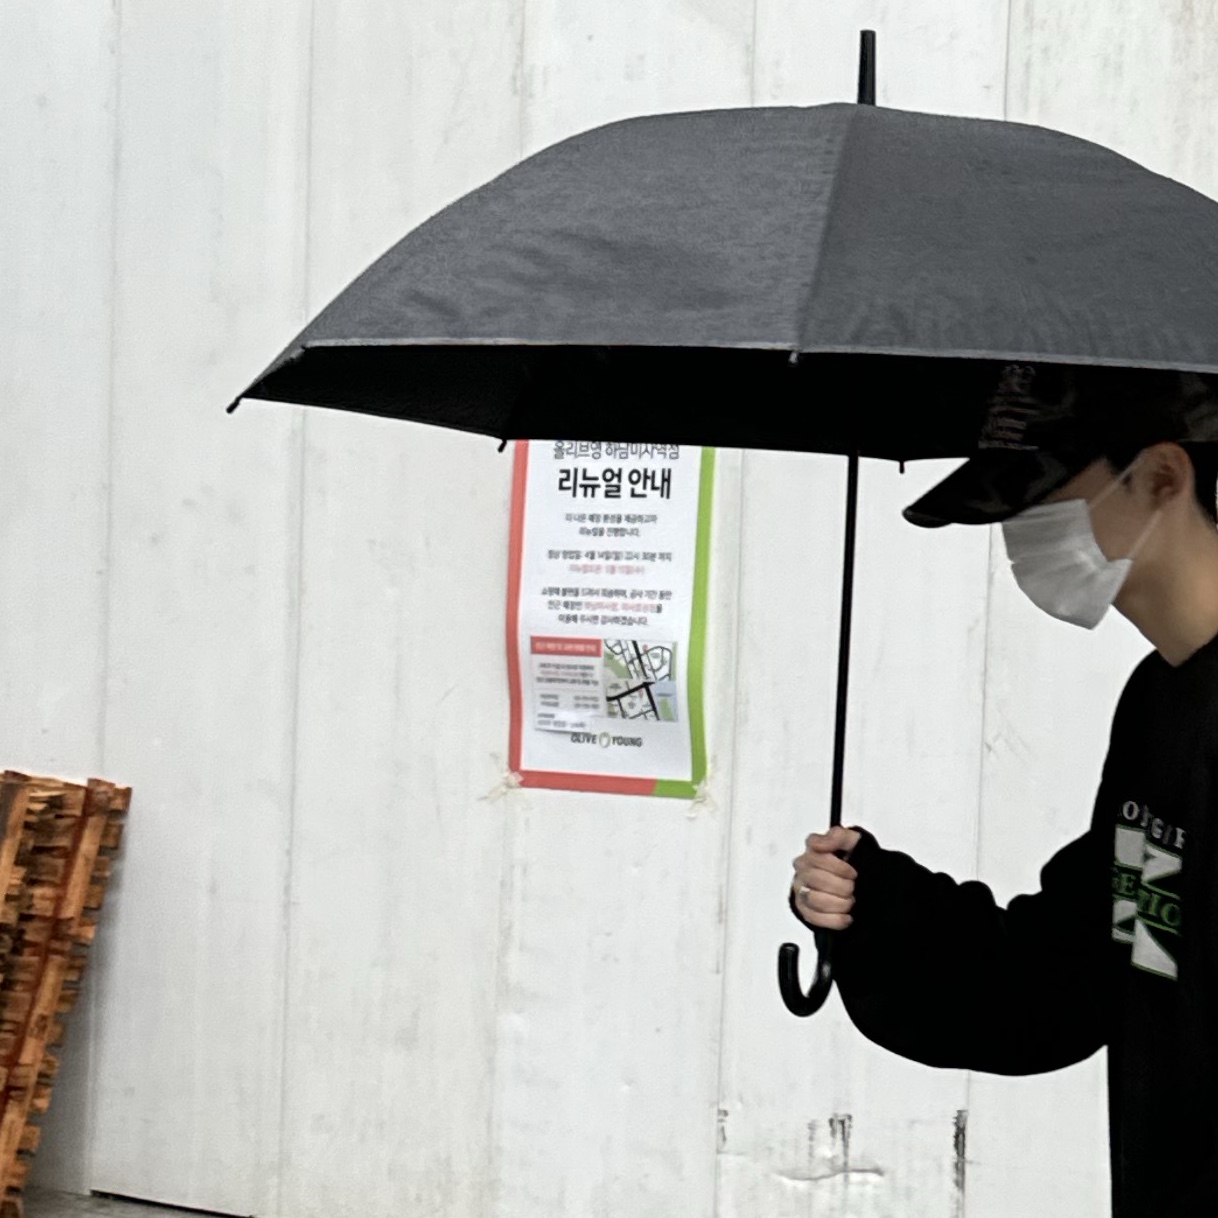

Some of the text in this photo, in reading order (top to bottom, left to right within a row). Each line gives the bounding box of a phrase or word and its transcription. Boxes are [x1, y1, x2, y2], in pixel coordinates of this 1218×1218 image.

[558, 467, 672, 499] 리뉴얼 안내
[571, 732, 643, 747] OLIVE YOUNG
